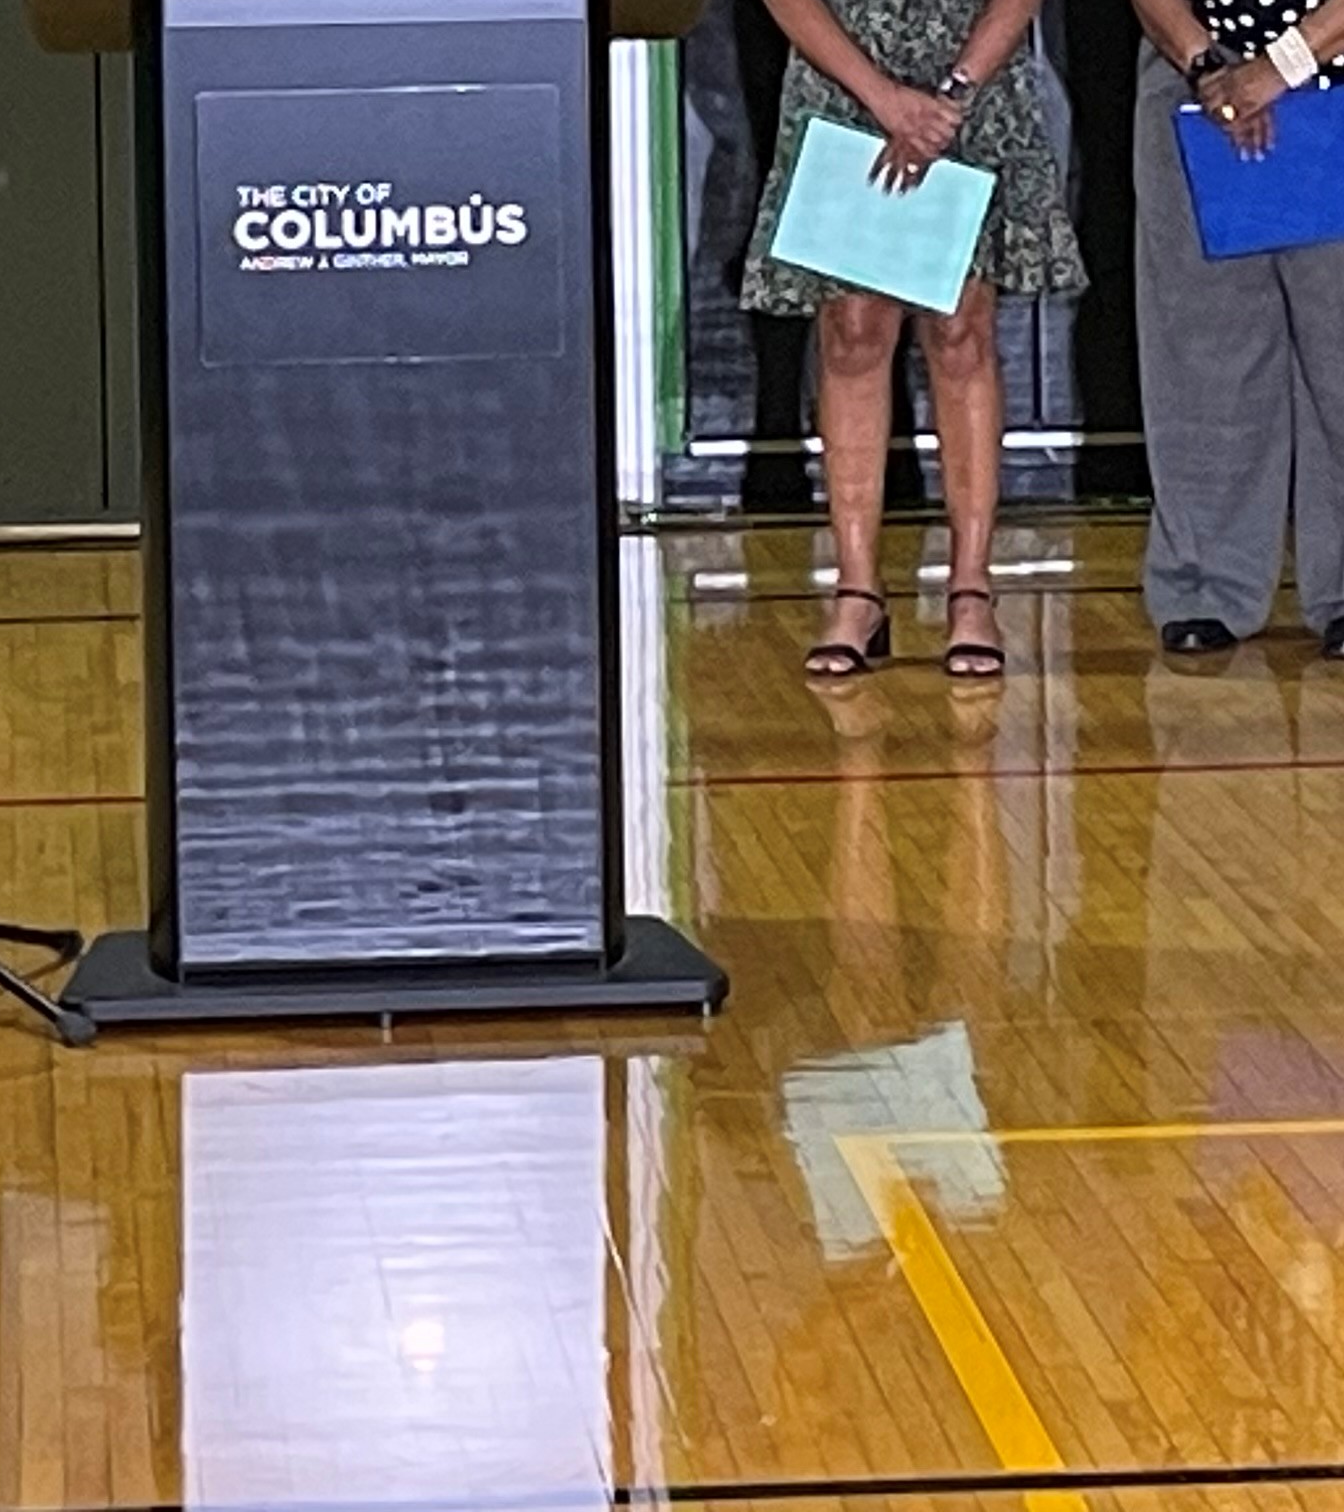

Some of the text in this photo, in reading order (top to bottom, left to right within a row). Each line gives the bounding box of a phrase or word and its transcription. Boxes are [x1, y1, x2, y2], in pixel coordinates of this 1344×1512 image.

[237, 182, 392, 208] THE CITY OF
[239, 254, 314, 271] ANDREW
[412, 250, 468, 267] MAYOR
